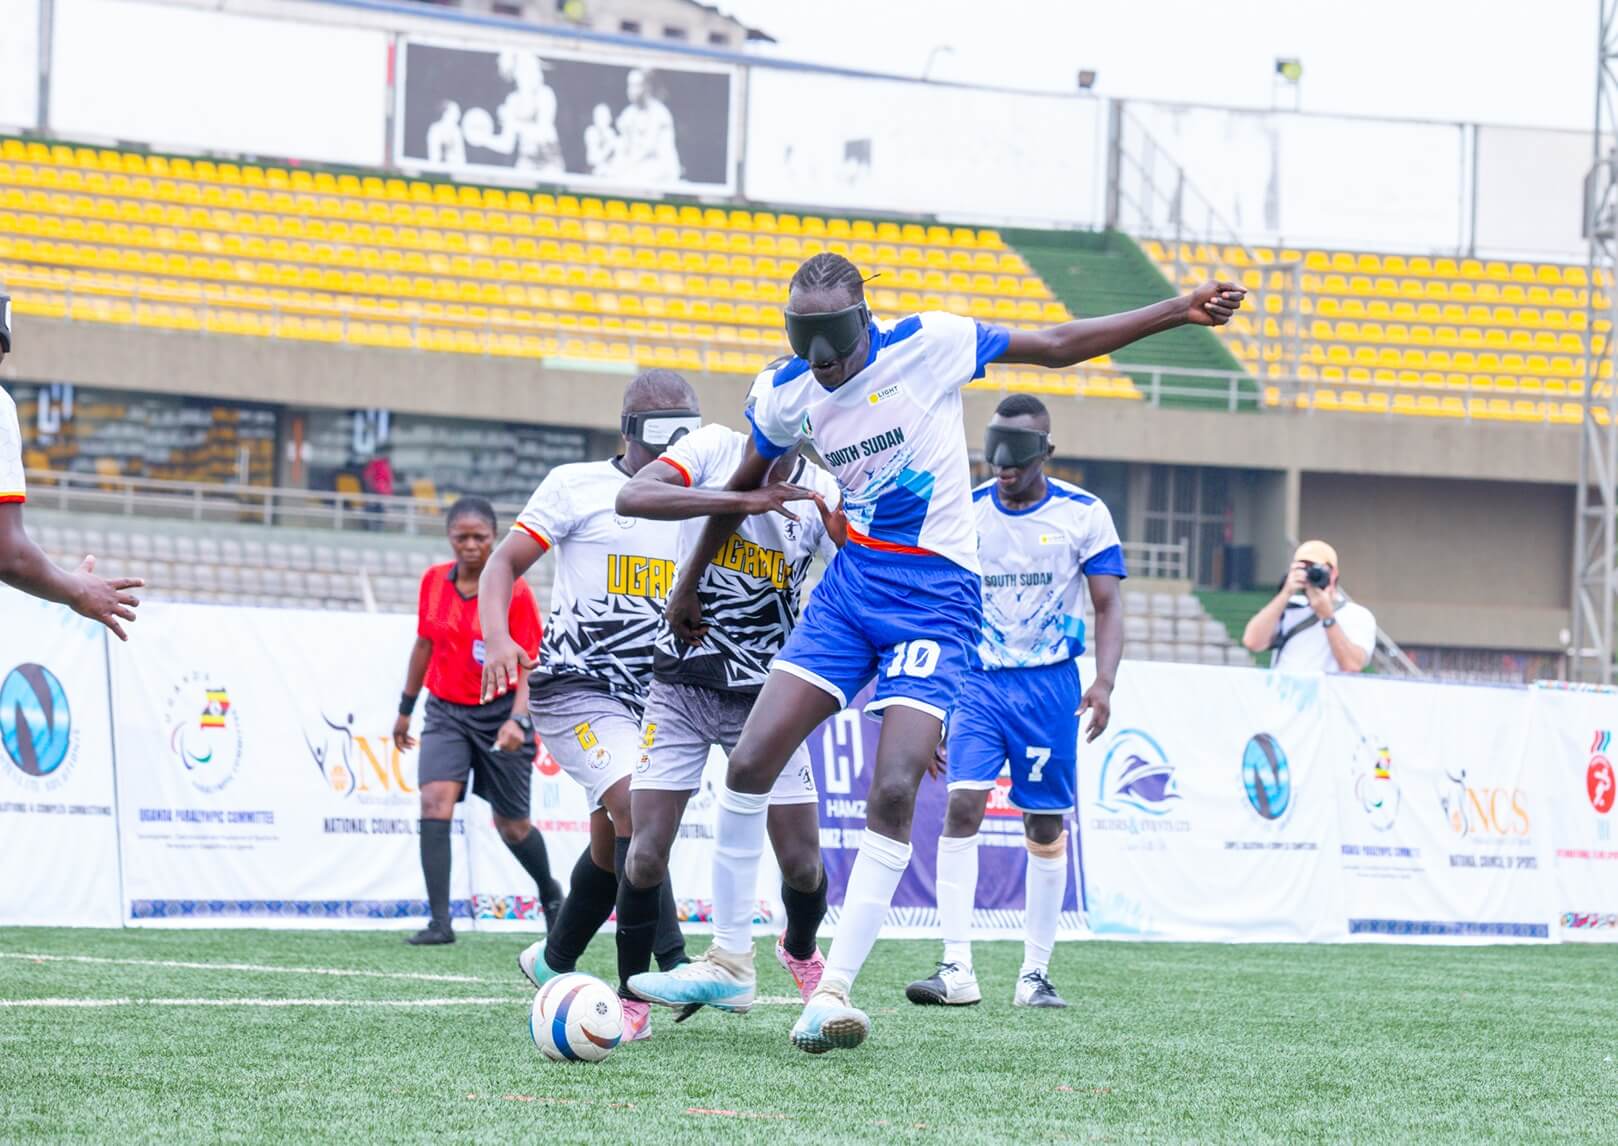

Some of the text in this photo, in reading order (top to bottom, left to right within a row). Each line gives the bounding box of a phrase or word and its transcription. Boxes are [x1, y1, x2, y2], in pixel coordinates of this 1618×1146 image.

[877, 385, 899, 398] LIGHT
[825, 426, 905, 467] SOUTH SUDAN
[710, 532, 792, 590] GAND
[984, 571, 1053, 588] SOUTH SUDAN
[886, 639, 941, 678] 10
[574, 721, 599, 752] 2
[352, 735, 421, 793] NC
[1026, 746, 1051, 782] 7
[323, 817, 369, 835] NATIONAL
[371, 818, 413, 835] COUNCIL
[1466, 787, 1531, 837] NCS
